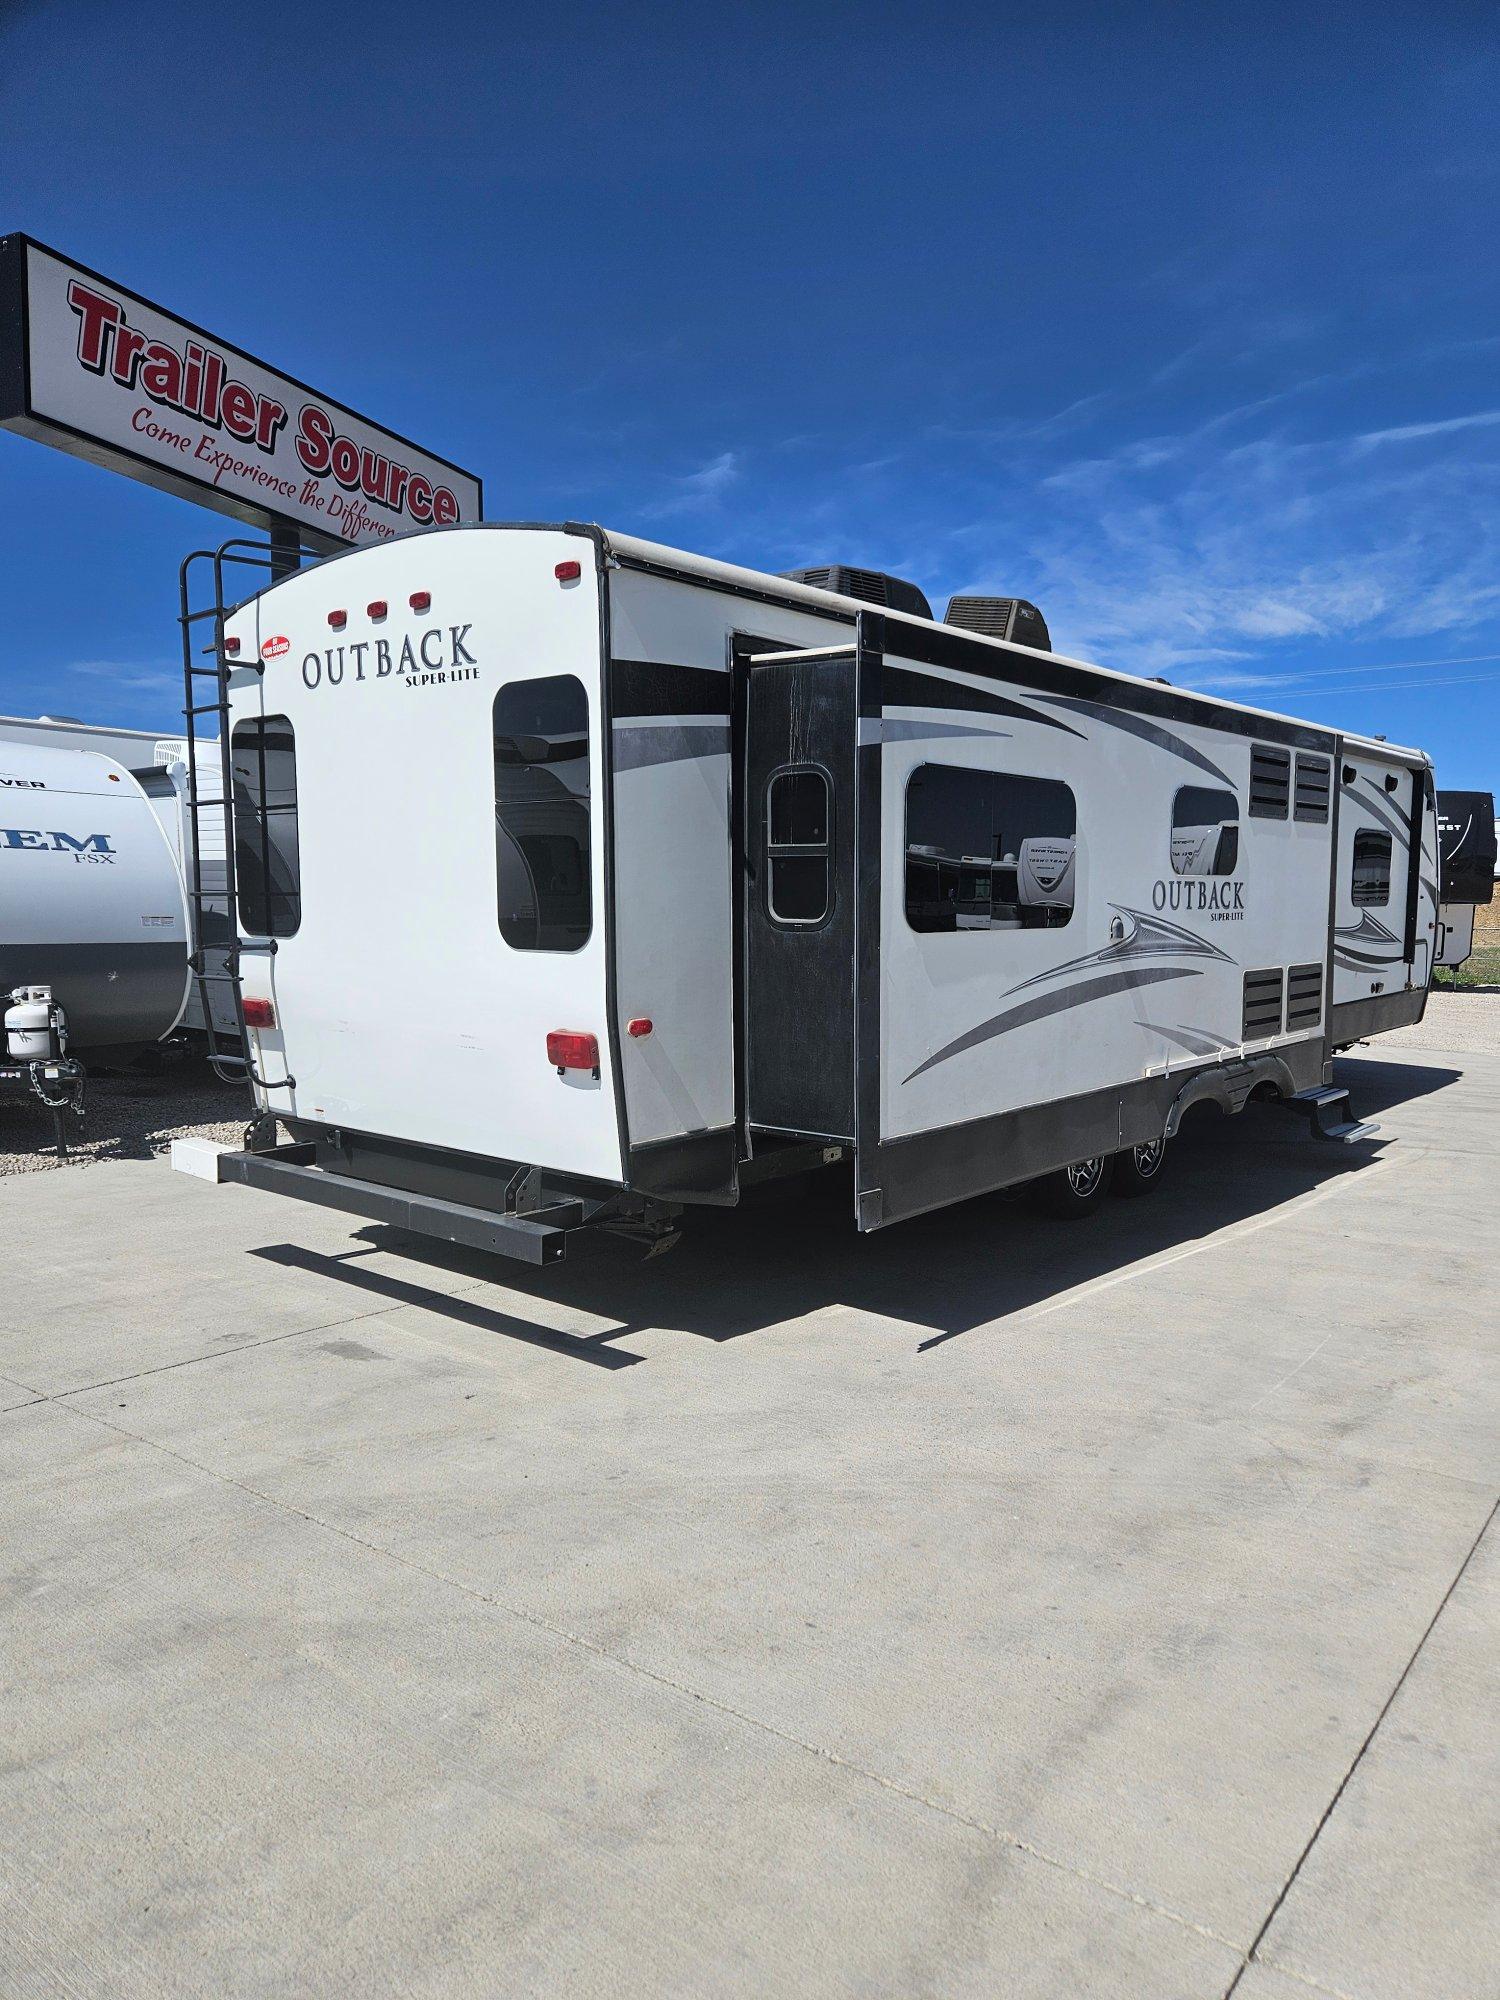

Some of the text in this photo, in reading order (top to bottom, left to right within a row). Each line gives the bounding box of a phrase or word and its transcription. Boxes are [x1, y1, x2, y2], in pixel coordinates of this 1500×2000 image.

[67, 279, 460, 525] Trailer Source
[132, 407, 399, 539] Come Experience the Differen
[302, 624, 477, 690] OUTBACK
[405, 667, 480, 688] SUPER-LITE
[0, 829, 117, 853] EM
[73, 853, 116, 864] FSX
[1152, 880, 1244, 911] OUTBACK
[1210, 912, 1244, 922] SUPER-LITE
